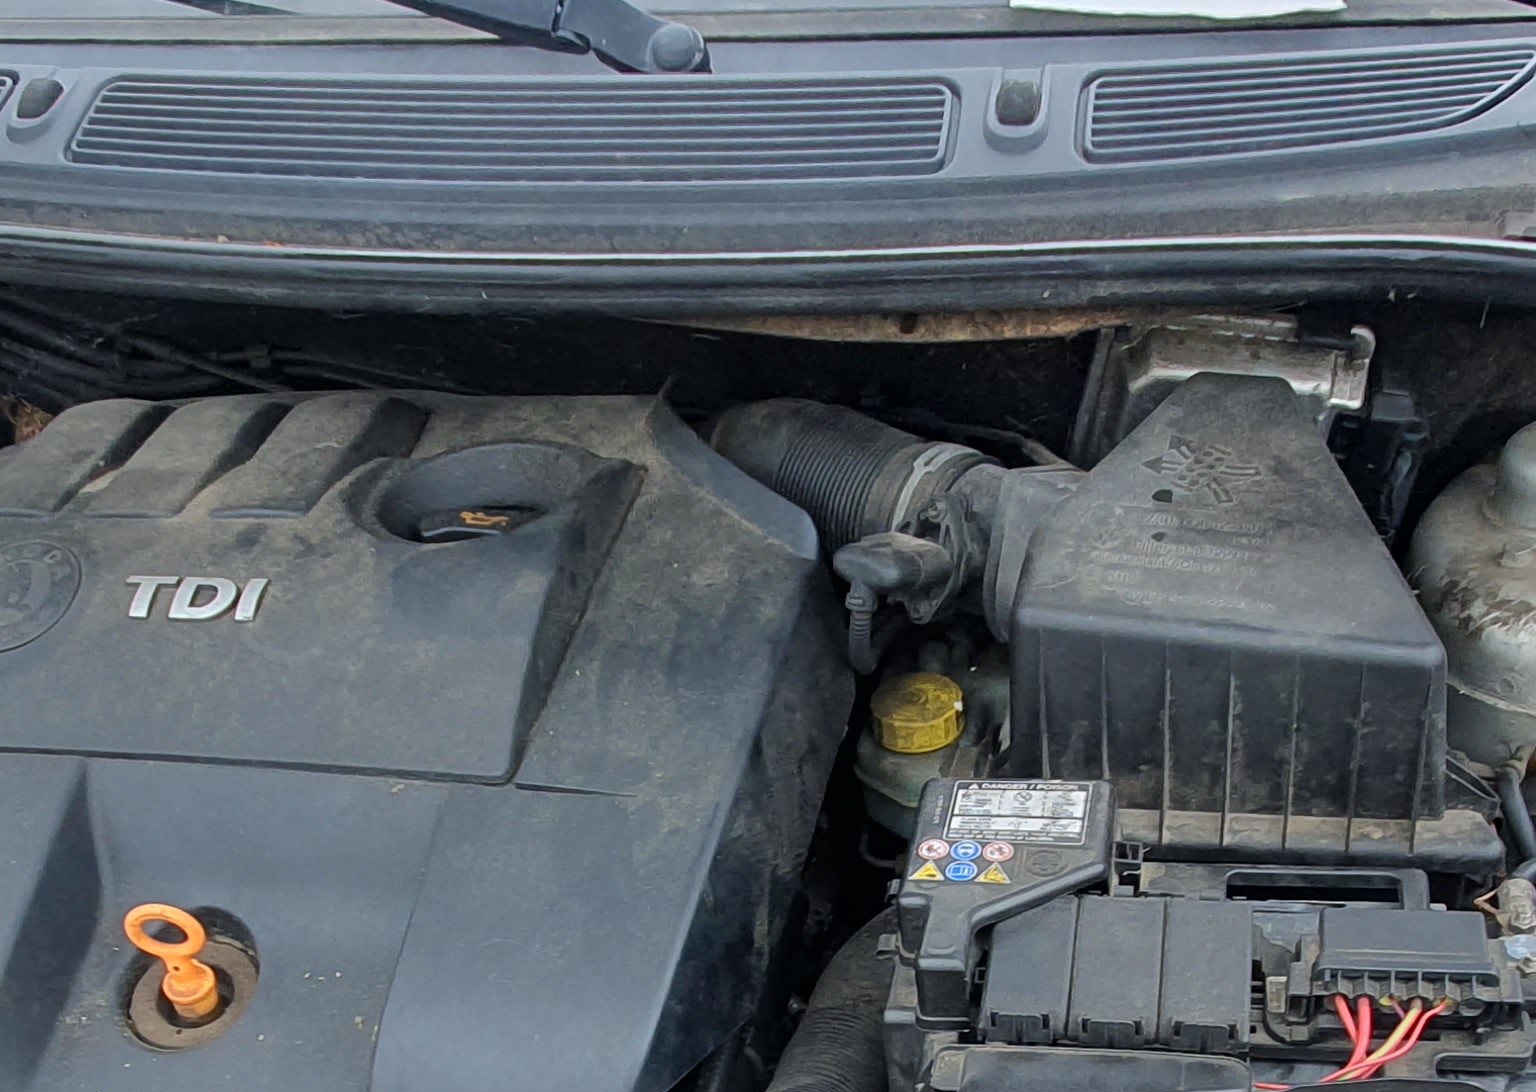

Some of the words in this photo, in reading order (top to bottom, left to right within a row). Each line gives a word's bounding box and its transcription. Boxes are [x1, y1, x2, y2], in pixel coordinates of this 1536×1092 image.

[126, 575, 270, 622] TDI
[981, 782, 1028, 790] DANGER
[1036, 783, 1079, 791] POISON
